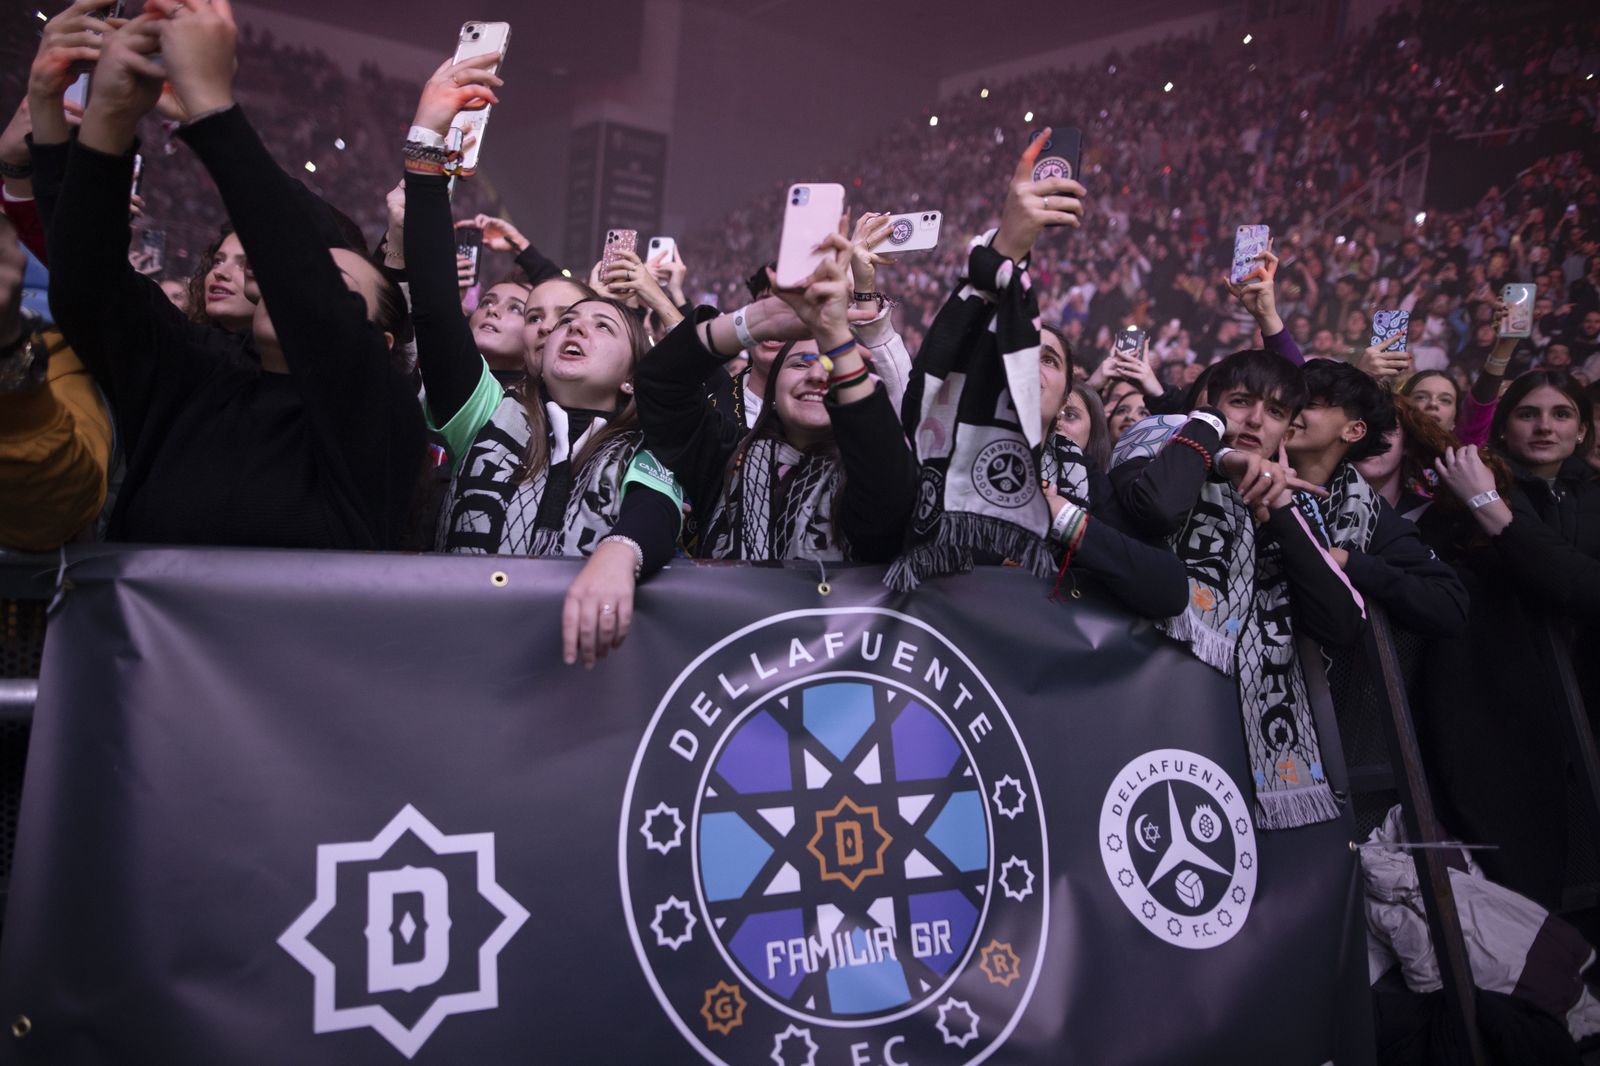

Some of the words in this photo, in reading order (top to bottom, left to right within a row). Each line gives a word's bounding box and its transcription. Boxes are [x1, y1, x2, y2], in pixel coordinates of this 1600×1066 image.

[669, 631, 993, 763] DELLAFUENTE
[1112, 760, 1233, 817] DELLAFUENTE
[765, 926, 898, 980] FAMILIA
[911, 919, 953, 958] GR
[1192, 922, 1217, 938] F.C.
[994, 953, 1009, 972] R
[716, 996, 734, 1018] G
